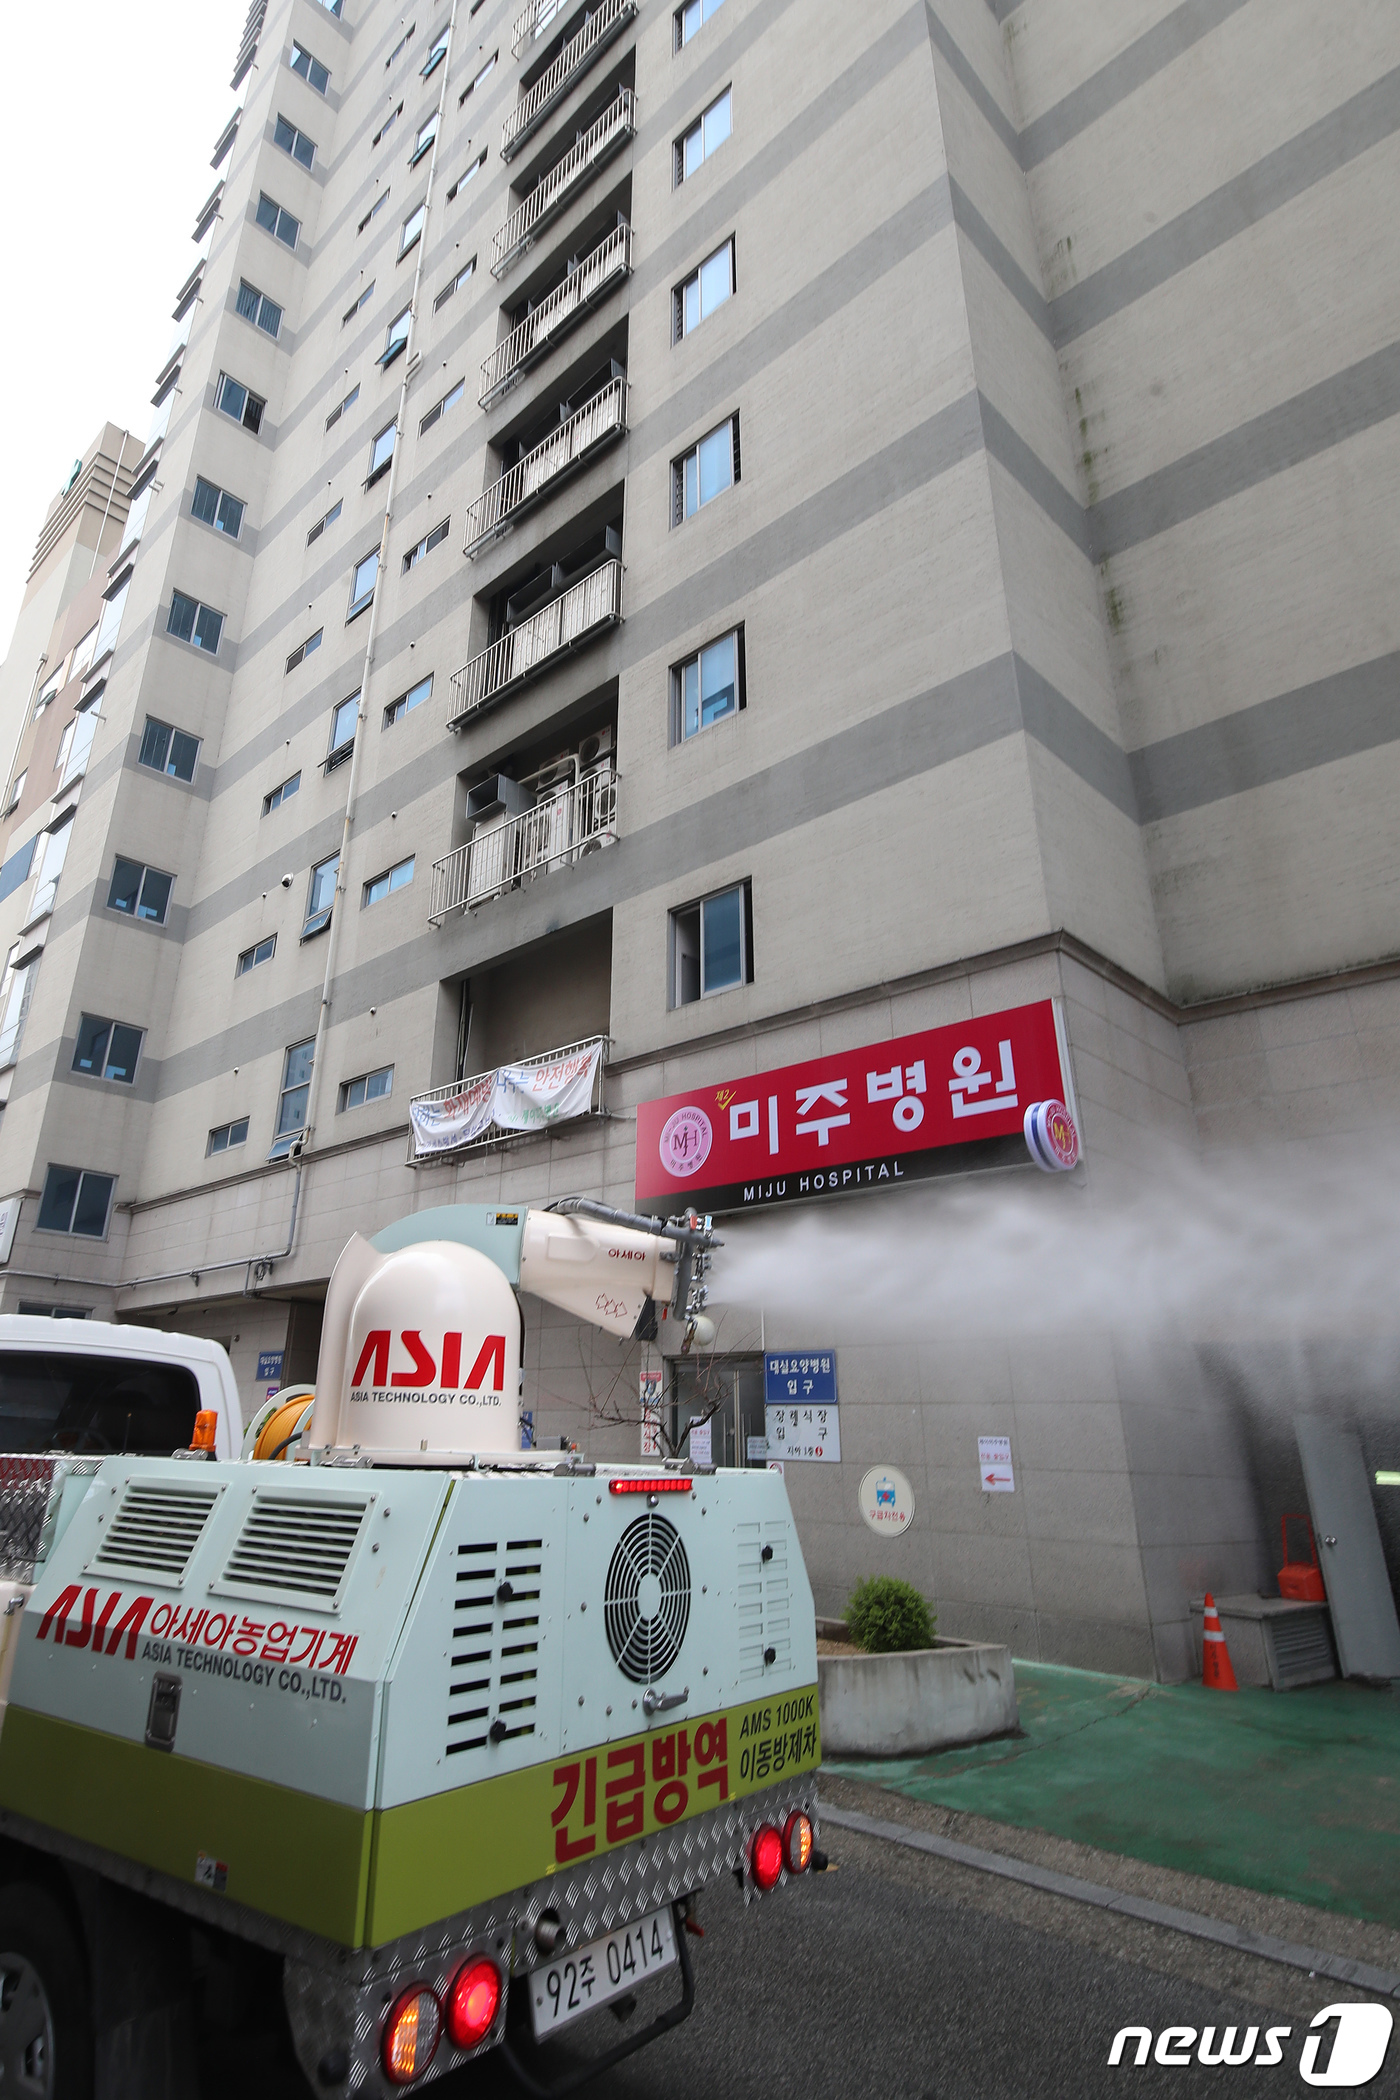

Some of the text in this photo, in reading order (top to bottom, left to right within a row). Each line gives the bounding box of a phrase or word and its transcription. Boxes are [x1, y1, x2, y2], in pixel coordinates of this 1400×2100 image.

[729, 1038, 1019, 1156] 미주병원
[743, 1164, 905, 1202] MIJU HOSPITAL
[608, 1247, 646, 1261] 아세아
[351, 1329, 506, 1391] ASIA
[769, 1357, 831, 1376] 대실요양병원
[787, 1378, 815, 1396] 입구
[350, 1391, 369, 1403] ASIA
[372, 1391, 456, 1405] TECHNOLOGY
[35, 1584, 155, 1661] ASIA
[150, 1602, 359, 1676] 아세아농업기계
[142, 1640, 172, 1665] ASIA
[176, 1646, 277, 1688] TECHNOLOGY
[739, 1694, 815, 1741] AMS 1000K
[739, 1722, 818, 1783] 이동방제차
[551, 1716, 730, 1864] 긴급방역
[546, 1918, 664, 2018] 92주 0414
